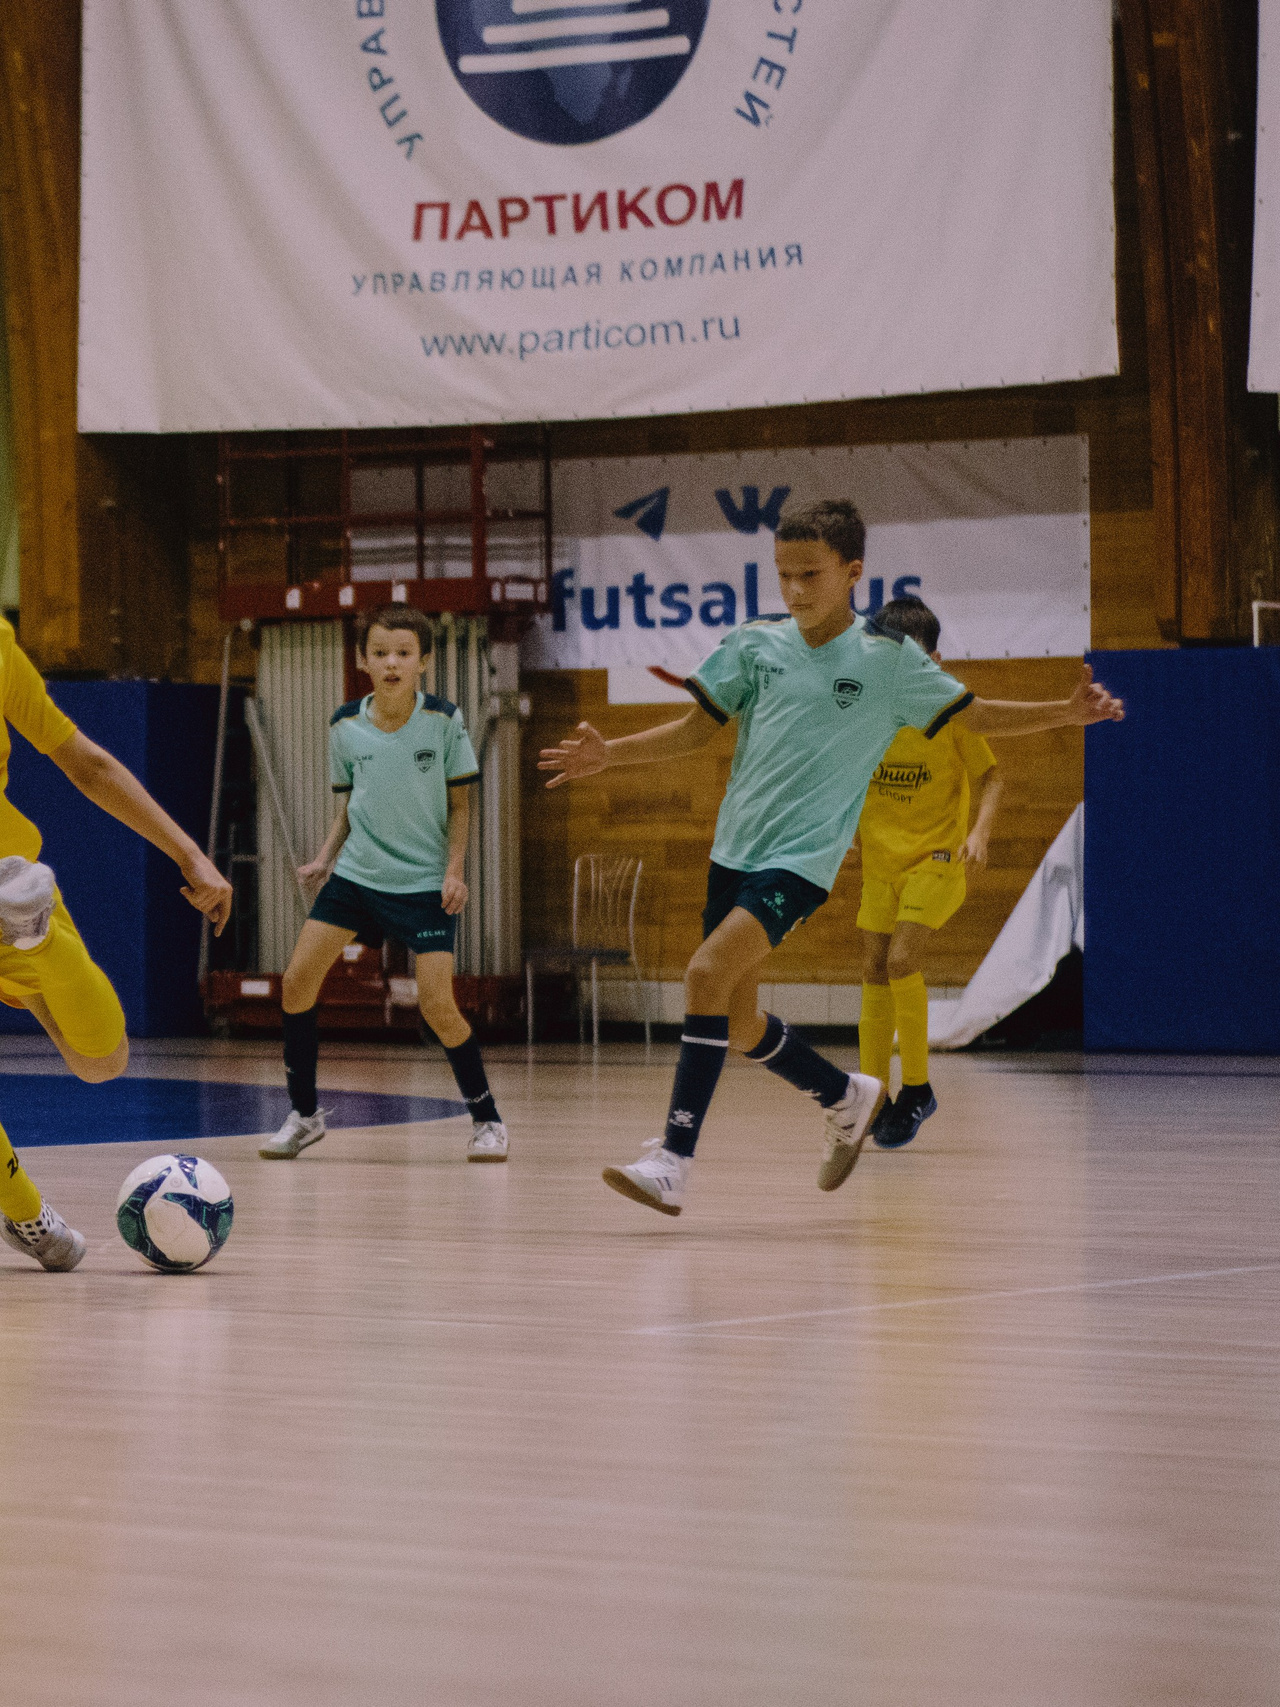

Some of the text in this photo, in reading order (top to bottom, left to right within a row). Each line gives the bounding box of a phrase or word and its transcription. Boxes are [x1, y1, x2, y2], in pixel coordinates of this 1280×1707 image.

[412, 178, 745, 242] ПАРТИКОМ
[351, 243, 804, 297] УПРАВЛЯЮЩАЯ КОМПАНИЯ
[420, 315, 741, 360] www.particom.ru
